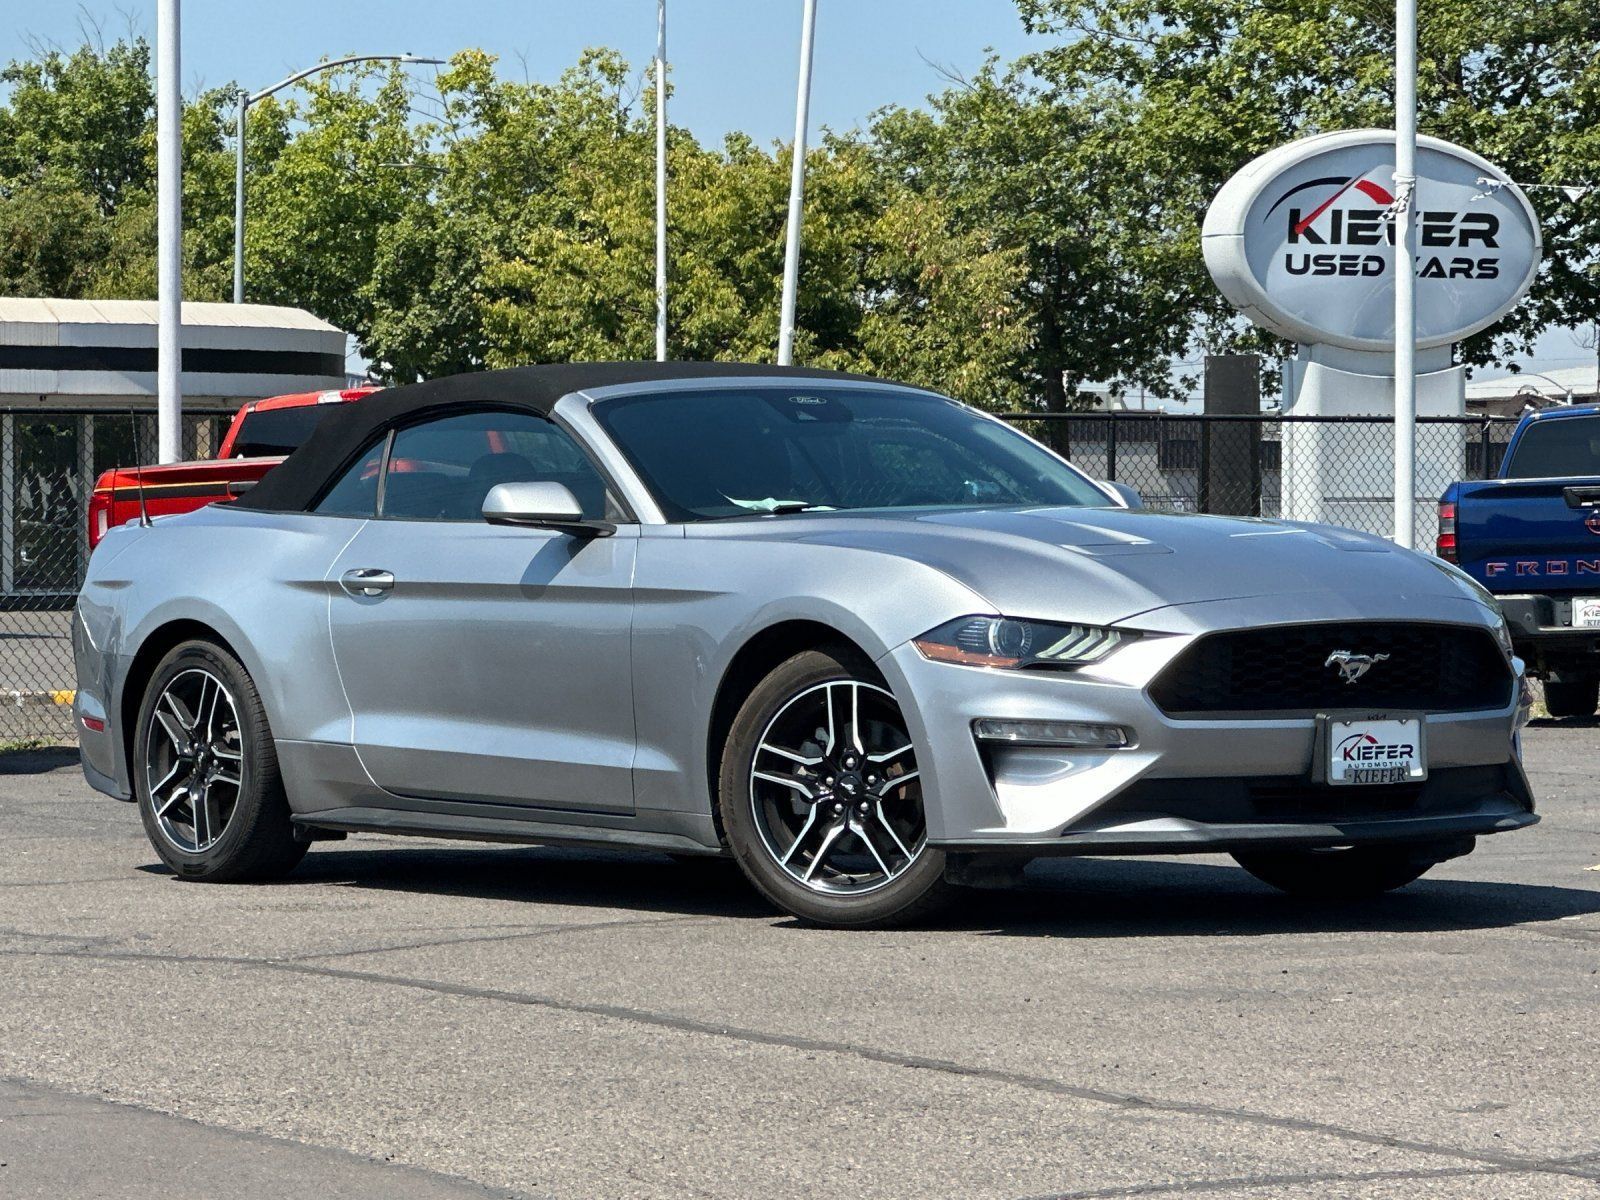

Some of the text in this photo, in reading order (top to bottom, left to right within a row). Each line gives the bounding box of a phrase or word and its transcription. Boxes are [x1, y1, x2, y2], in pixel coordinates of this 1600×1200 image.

[1287, 208, 1500, 247] KIEER
[1285, 253, 1499, 279] USED ARS
[1343, 744, 1414, 761] KIEFER
[1347, 760, 1410, 769] AUTOMOTIVE
[1352, 767, 1406, 784] KIEFER
